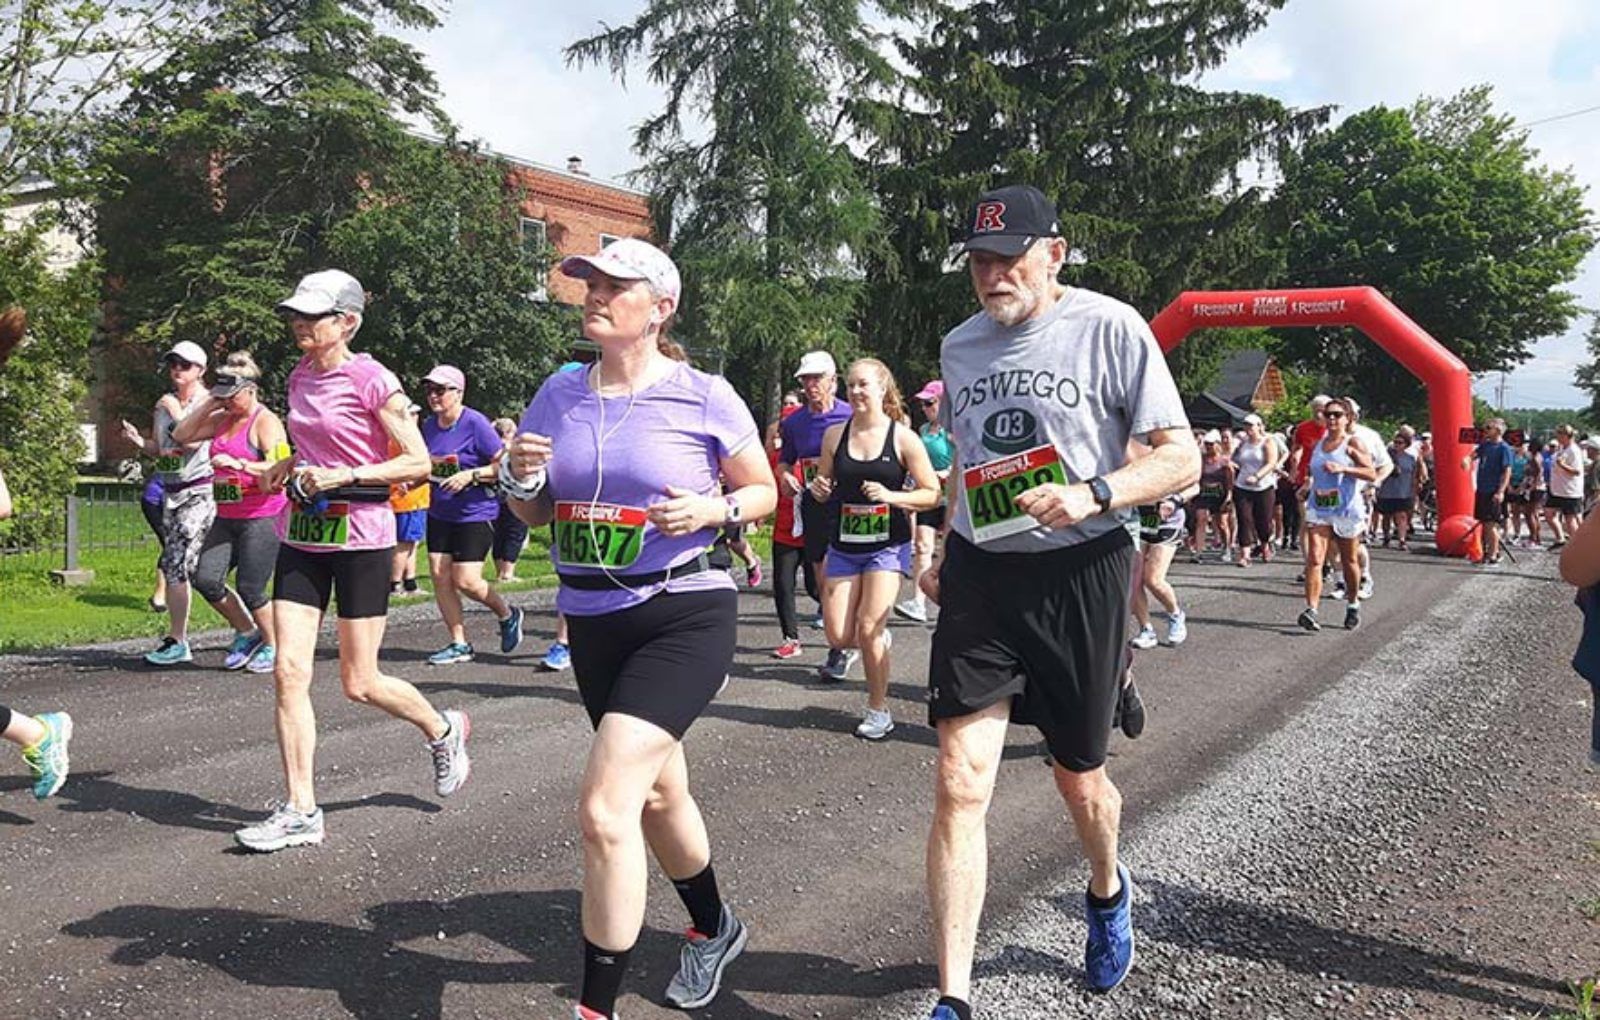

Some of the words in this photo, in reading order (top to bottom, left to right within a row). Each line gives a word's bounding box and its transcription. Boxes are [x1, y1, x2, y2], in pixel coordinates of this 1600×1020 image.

[974, 202, 1006, 232] R
[1253, 297, 1287, 305] START
[954, 370, 1080, 417] OSWEGO
[995, 411, 1025, 438] 03
[288, 512, 341, 543] 4037
[560, 523, 635, 565] 4597
